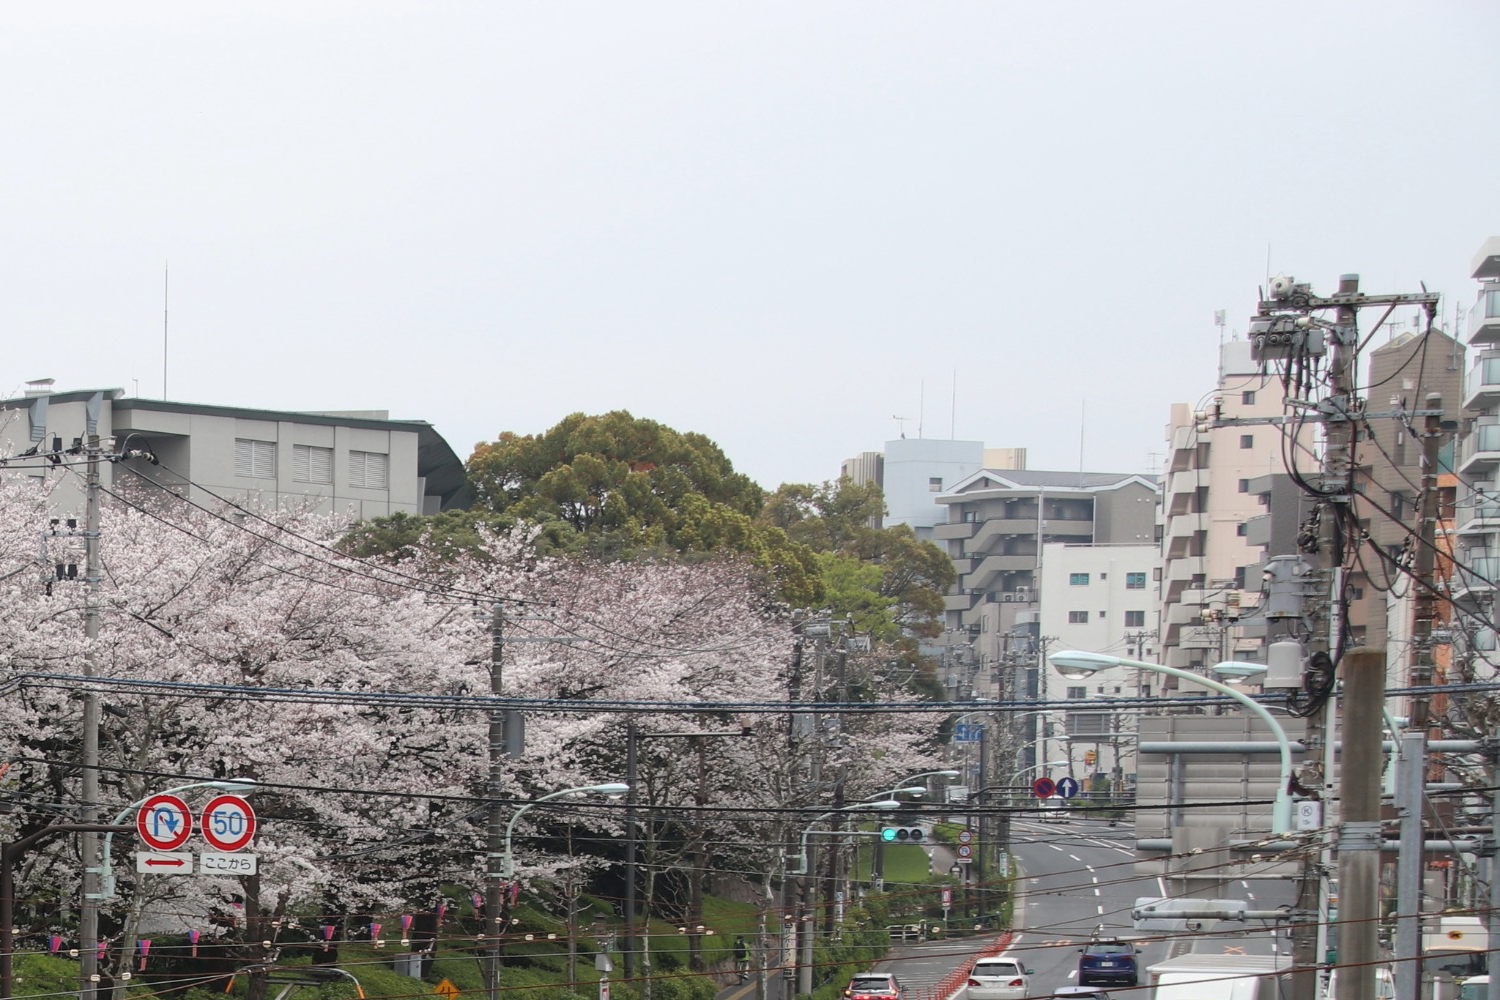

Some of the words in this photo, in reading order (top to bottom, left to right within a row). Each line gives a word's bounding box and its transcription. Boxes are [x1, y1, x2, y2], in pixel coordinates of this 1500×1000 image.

[214, 811, 243, 835] 50
[205, 857, 251, 870] ここから
